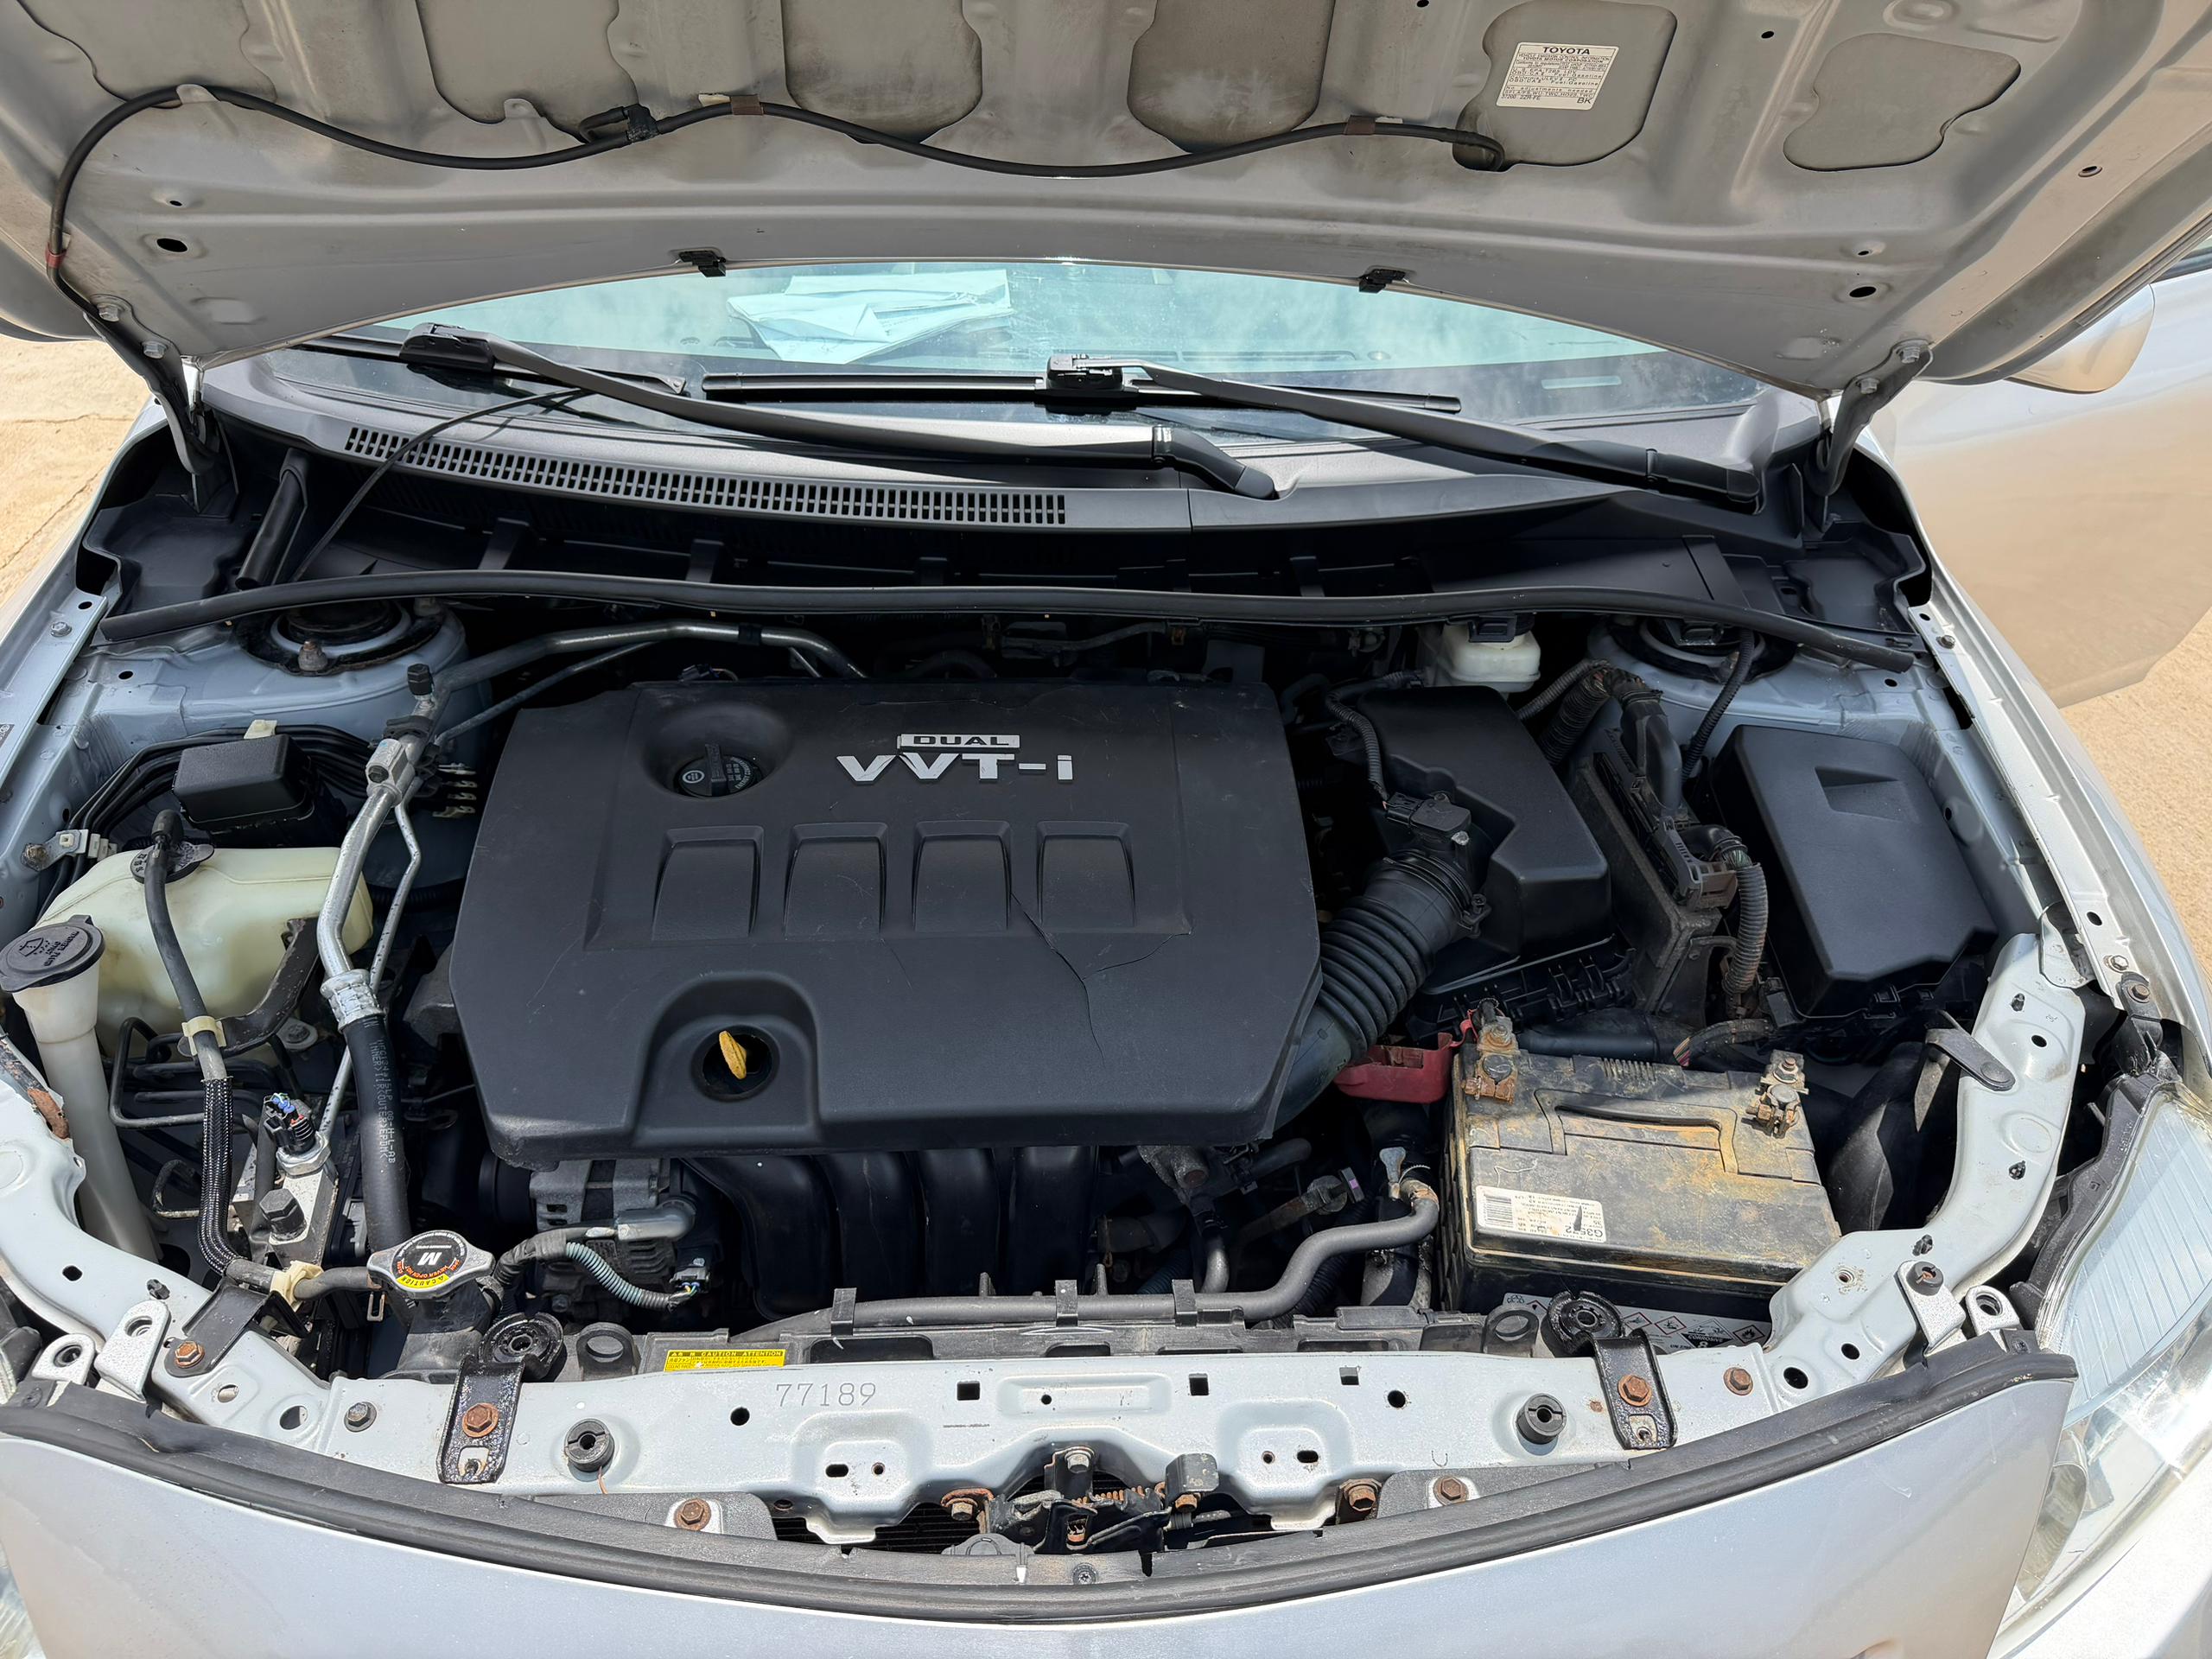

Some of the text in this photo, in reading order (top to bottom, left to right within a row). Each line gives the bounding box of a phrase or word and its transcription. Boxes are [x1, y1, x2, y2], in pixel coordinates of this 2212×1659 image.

[1542, 47, 1591, 55] TOYOTA
[913, 735, 1009, 746] DUAL
[836, 752, 1074, 782] VVT-i
[429, 1265, 448, 1278] NEVER
[400, 1276, 436, 1286] CAUTION
[1688, 1334, 1724, 1343] CORROSIVE
[776, 1382, 877, 1408] 77189
